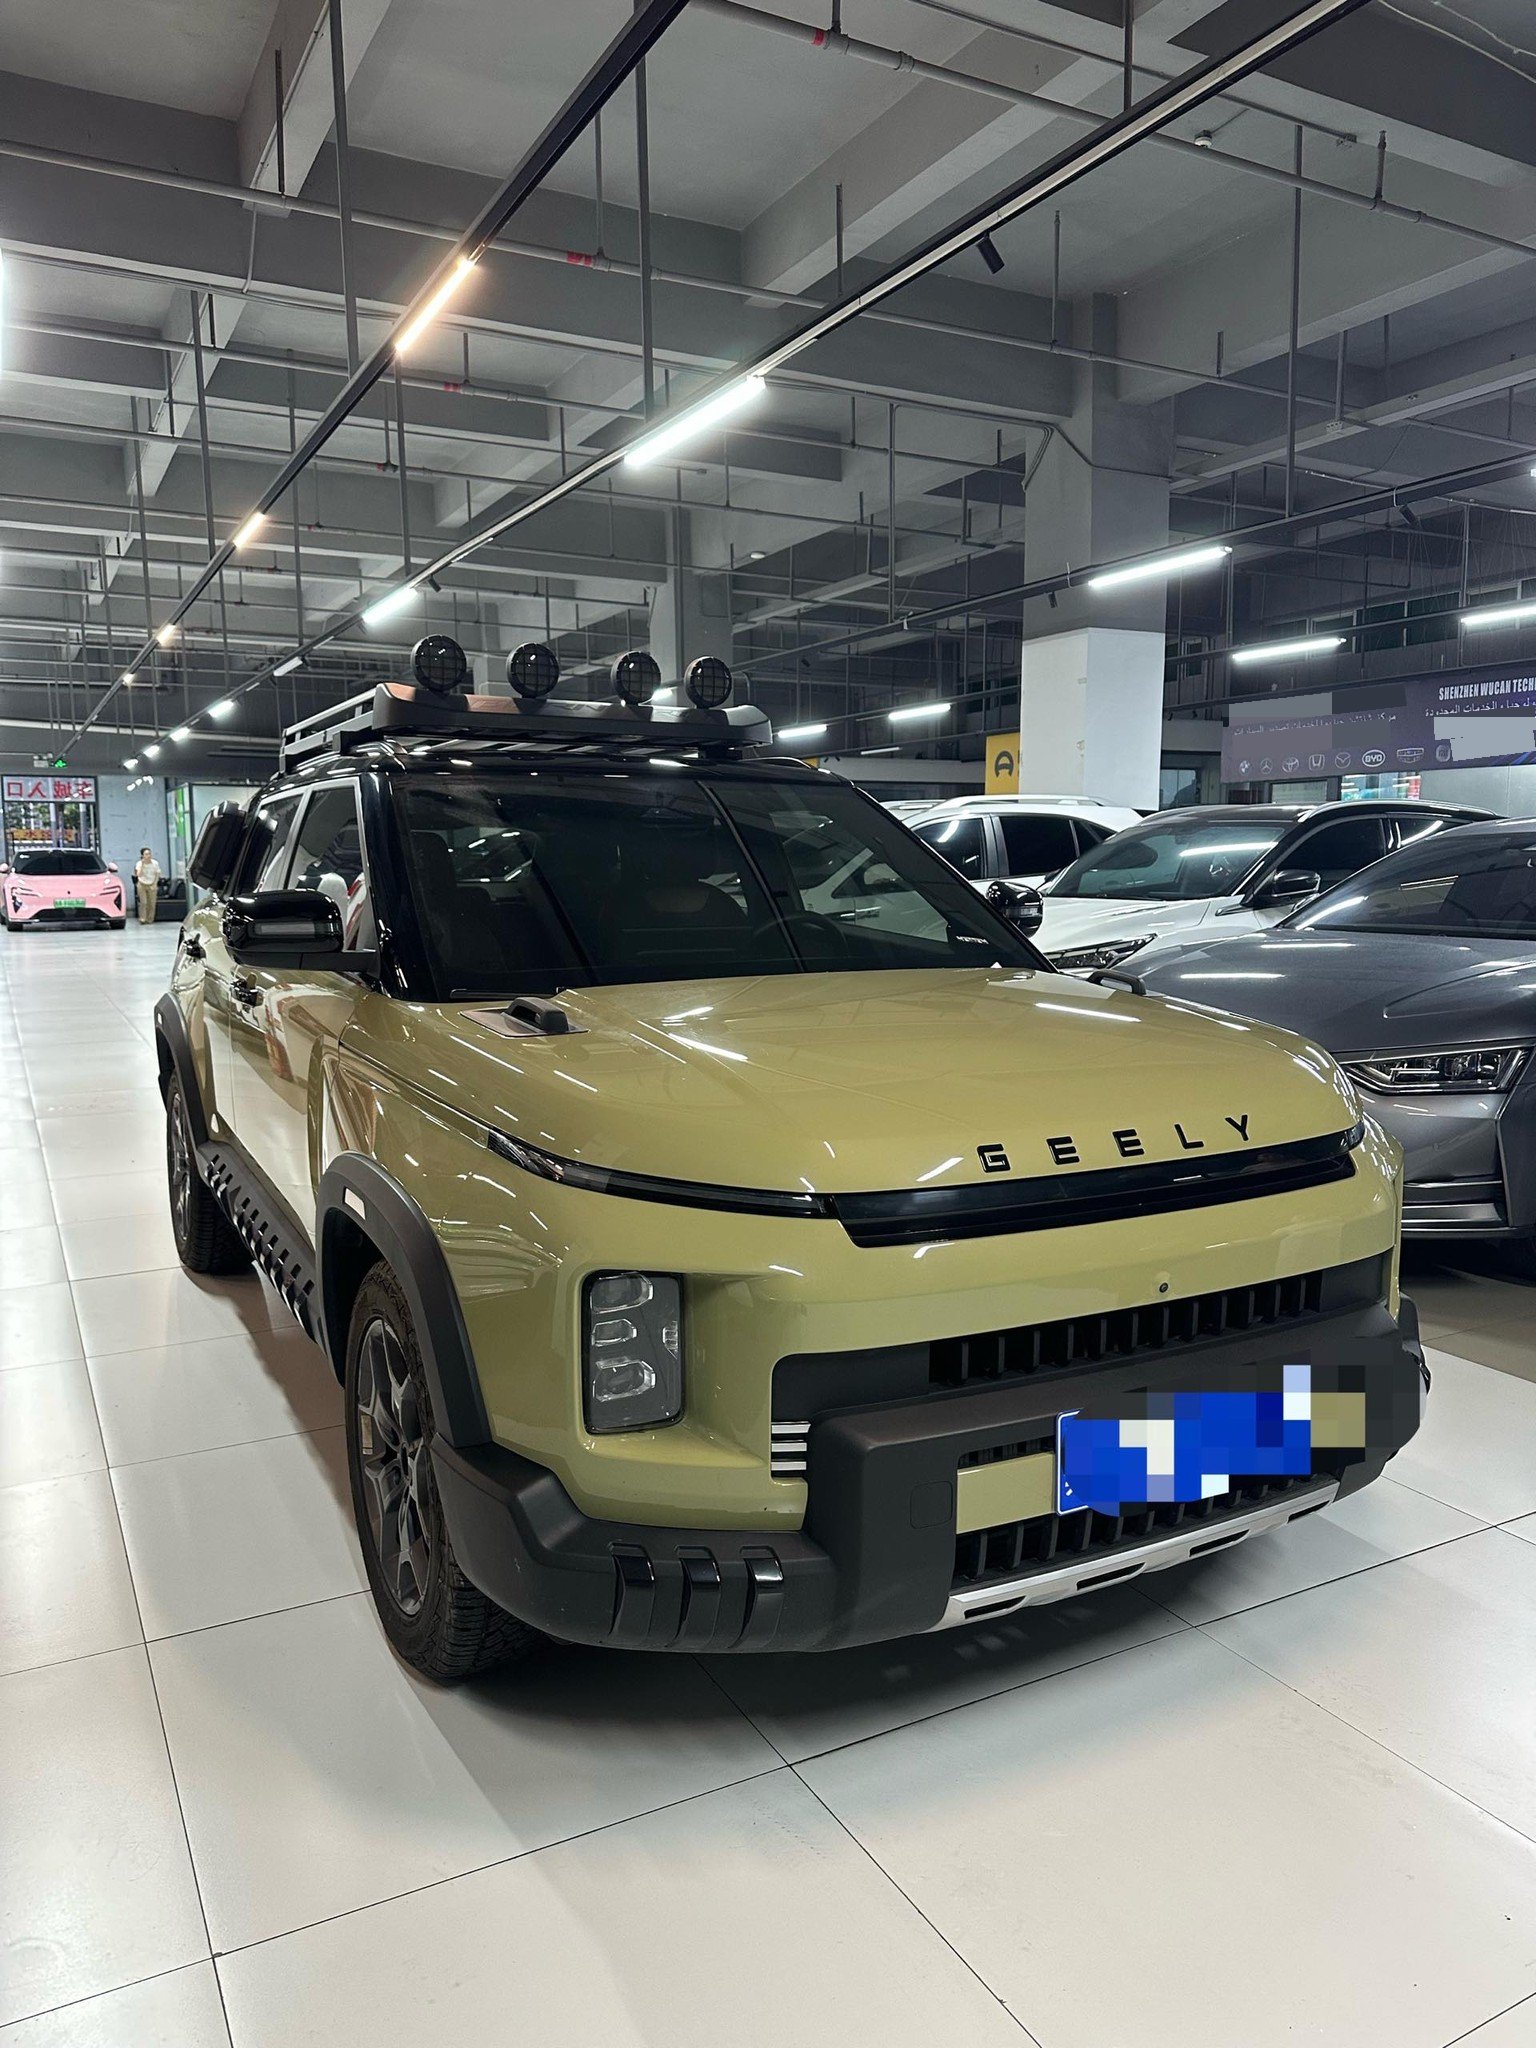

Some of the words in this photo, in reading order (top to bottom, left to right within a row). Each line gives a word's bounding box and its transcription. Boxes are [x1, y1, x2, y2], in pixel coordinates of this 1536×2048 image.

[1439, 684, 1480, 701] SHENZHEN
[1480, 680, 1511, 696] WUCAN
[976, 1114, 1249, 1173] GEELY
